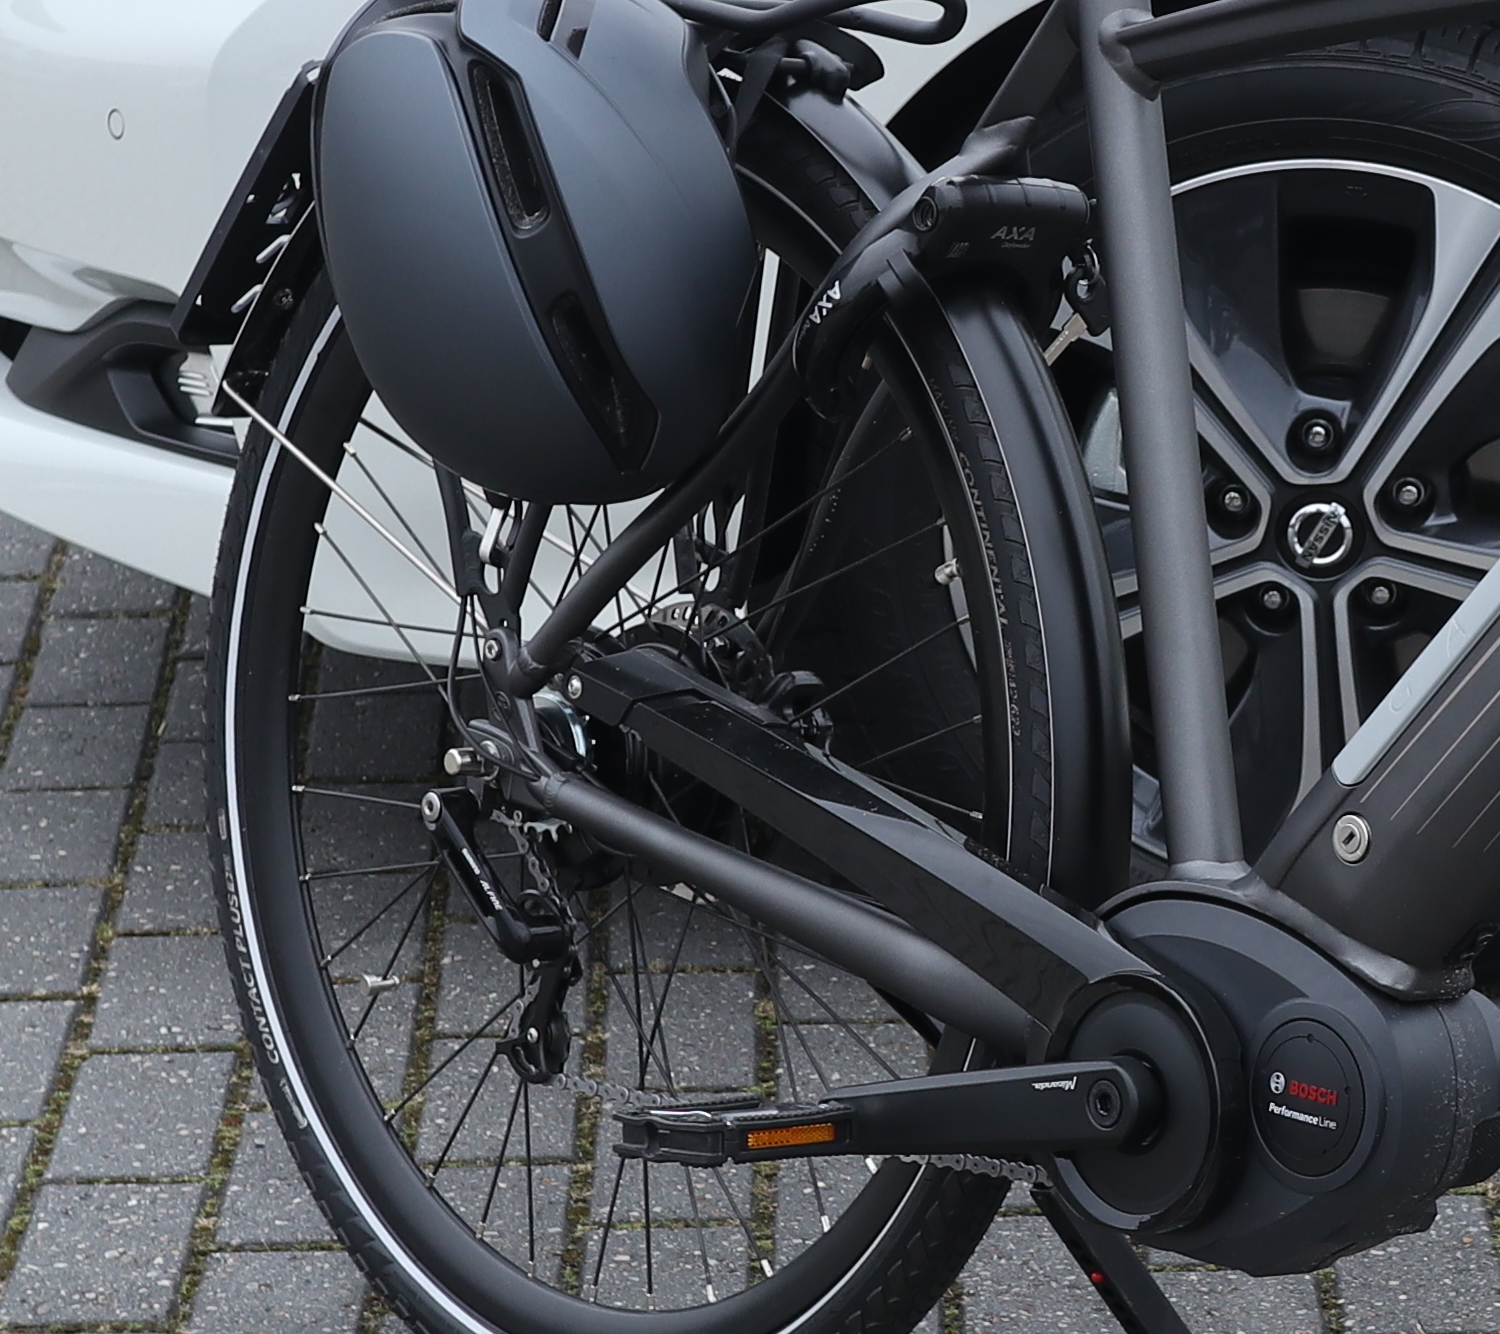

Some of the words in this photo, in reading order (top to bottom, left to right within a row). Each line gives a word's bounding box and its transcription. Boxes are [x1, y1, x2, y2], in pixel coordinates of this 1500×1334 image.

[990, 225, 1036, 241] AXA
[809, 279, 841, 324] AXA
[1302, 511, 1340, 563] NISSAN
[228, 891, 247, 953] PLUS
[240, 957, 279, 1065] CONTACT
[1289, 1080, 1339, 1105] BOSCH
[1268, 1102, 1319, 1125] Performance
[1318, 1115, 1337, 1130] Line
